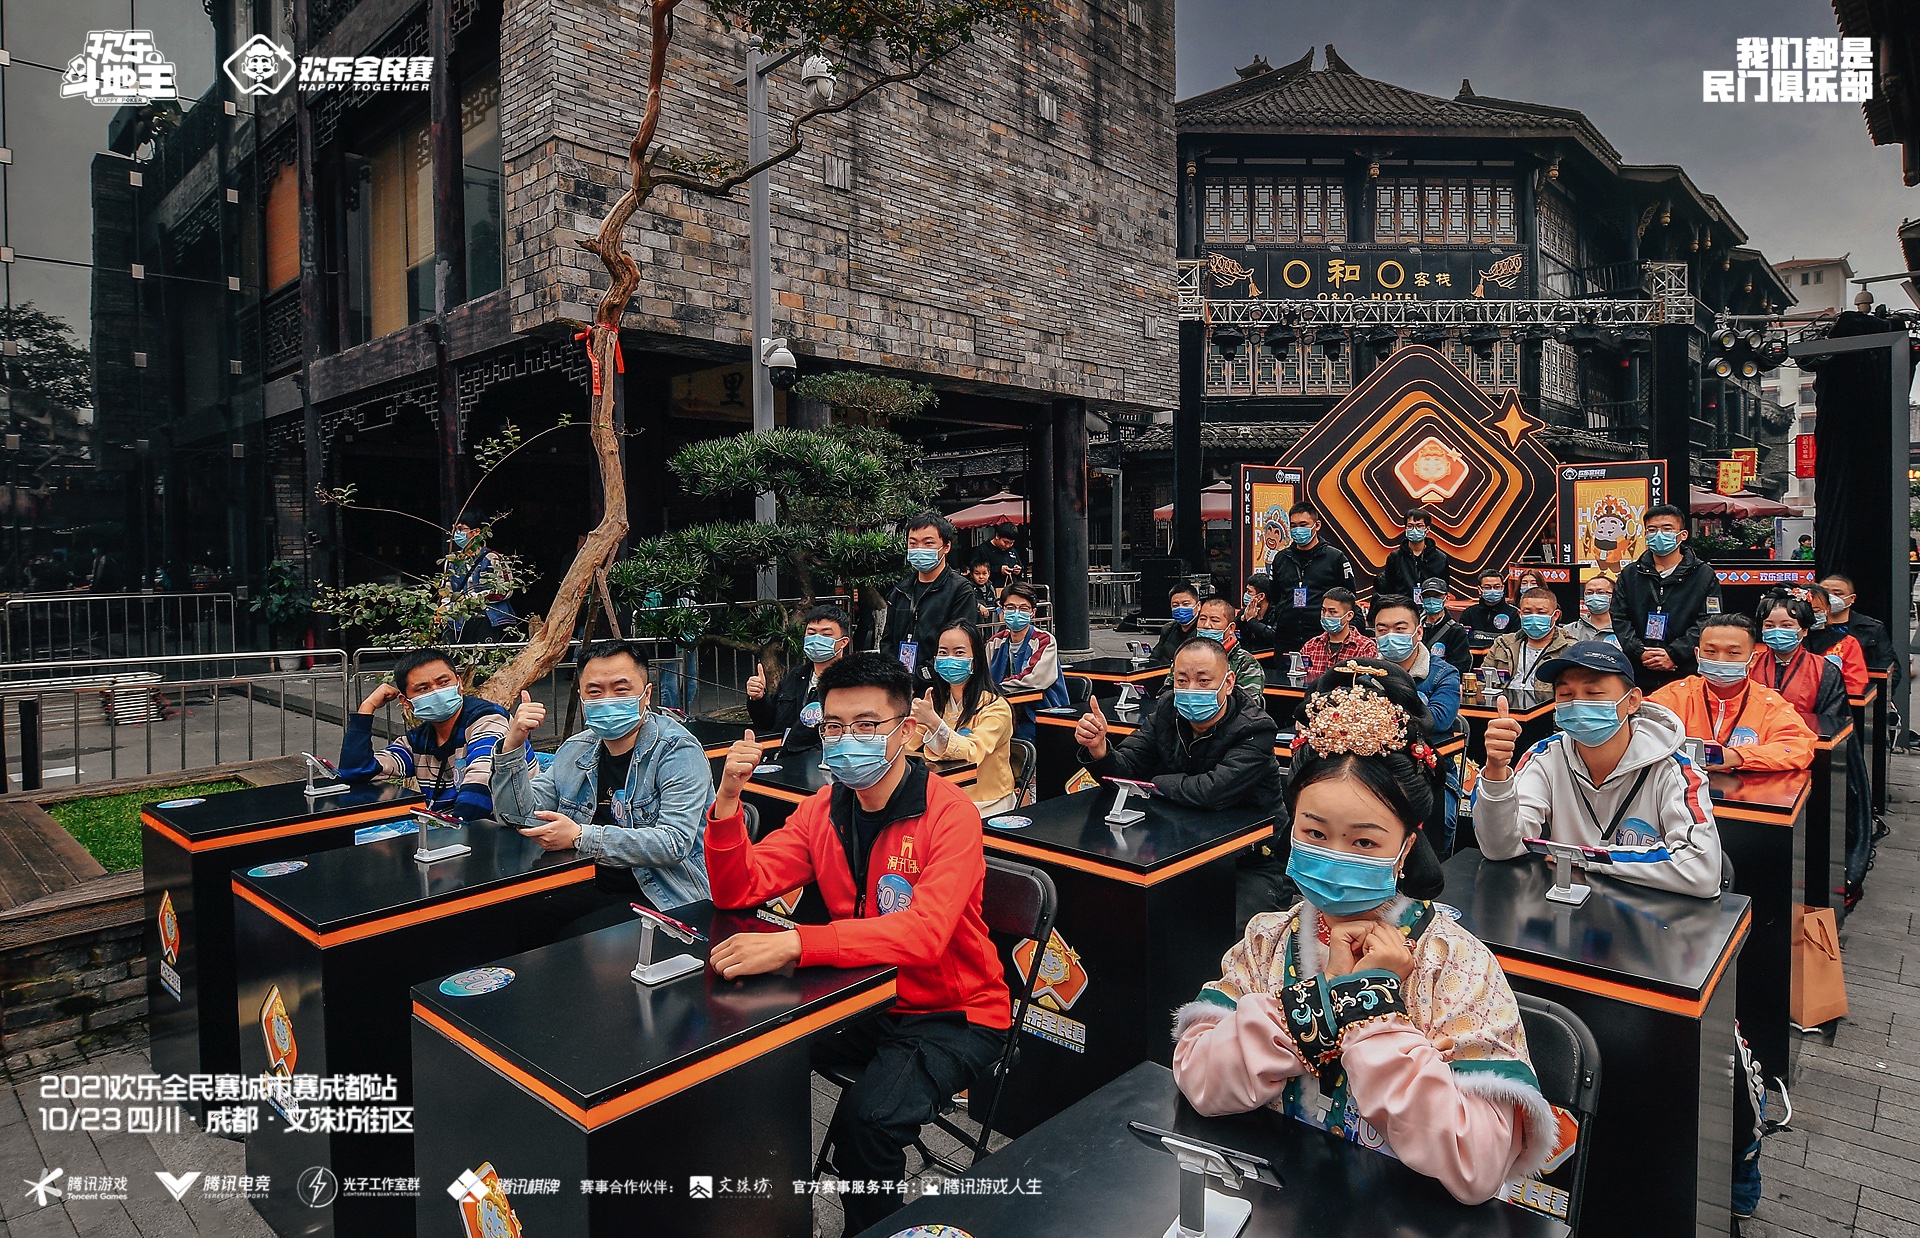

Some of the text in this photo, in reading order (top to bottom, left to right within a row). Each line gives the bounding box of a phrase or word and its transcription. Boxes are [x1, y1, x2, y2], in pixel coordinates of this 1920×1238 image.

[1413, 271, 1452, 287] 客栈
[1651, 466, 1662, 507] JOKE
[1041, 1032, 1086, 1054] TOGETHER
